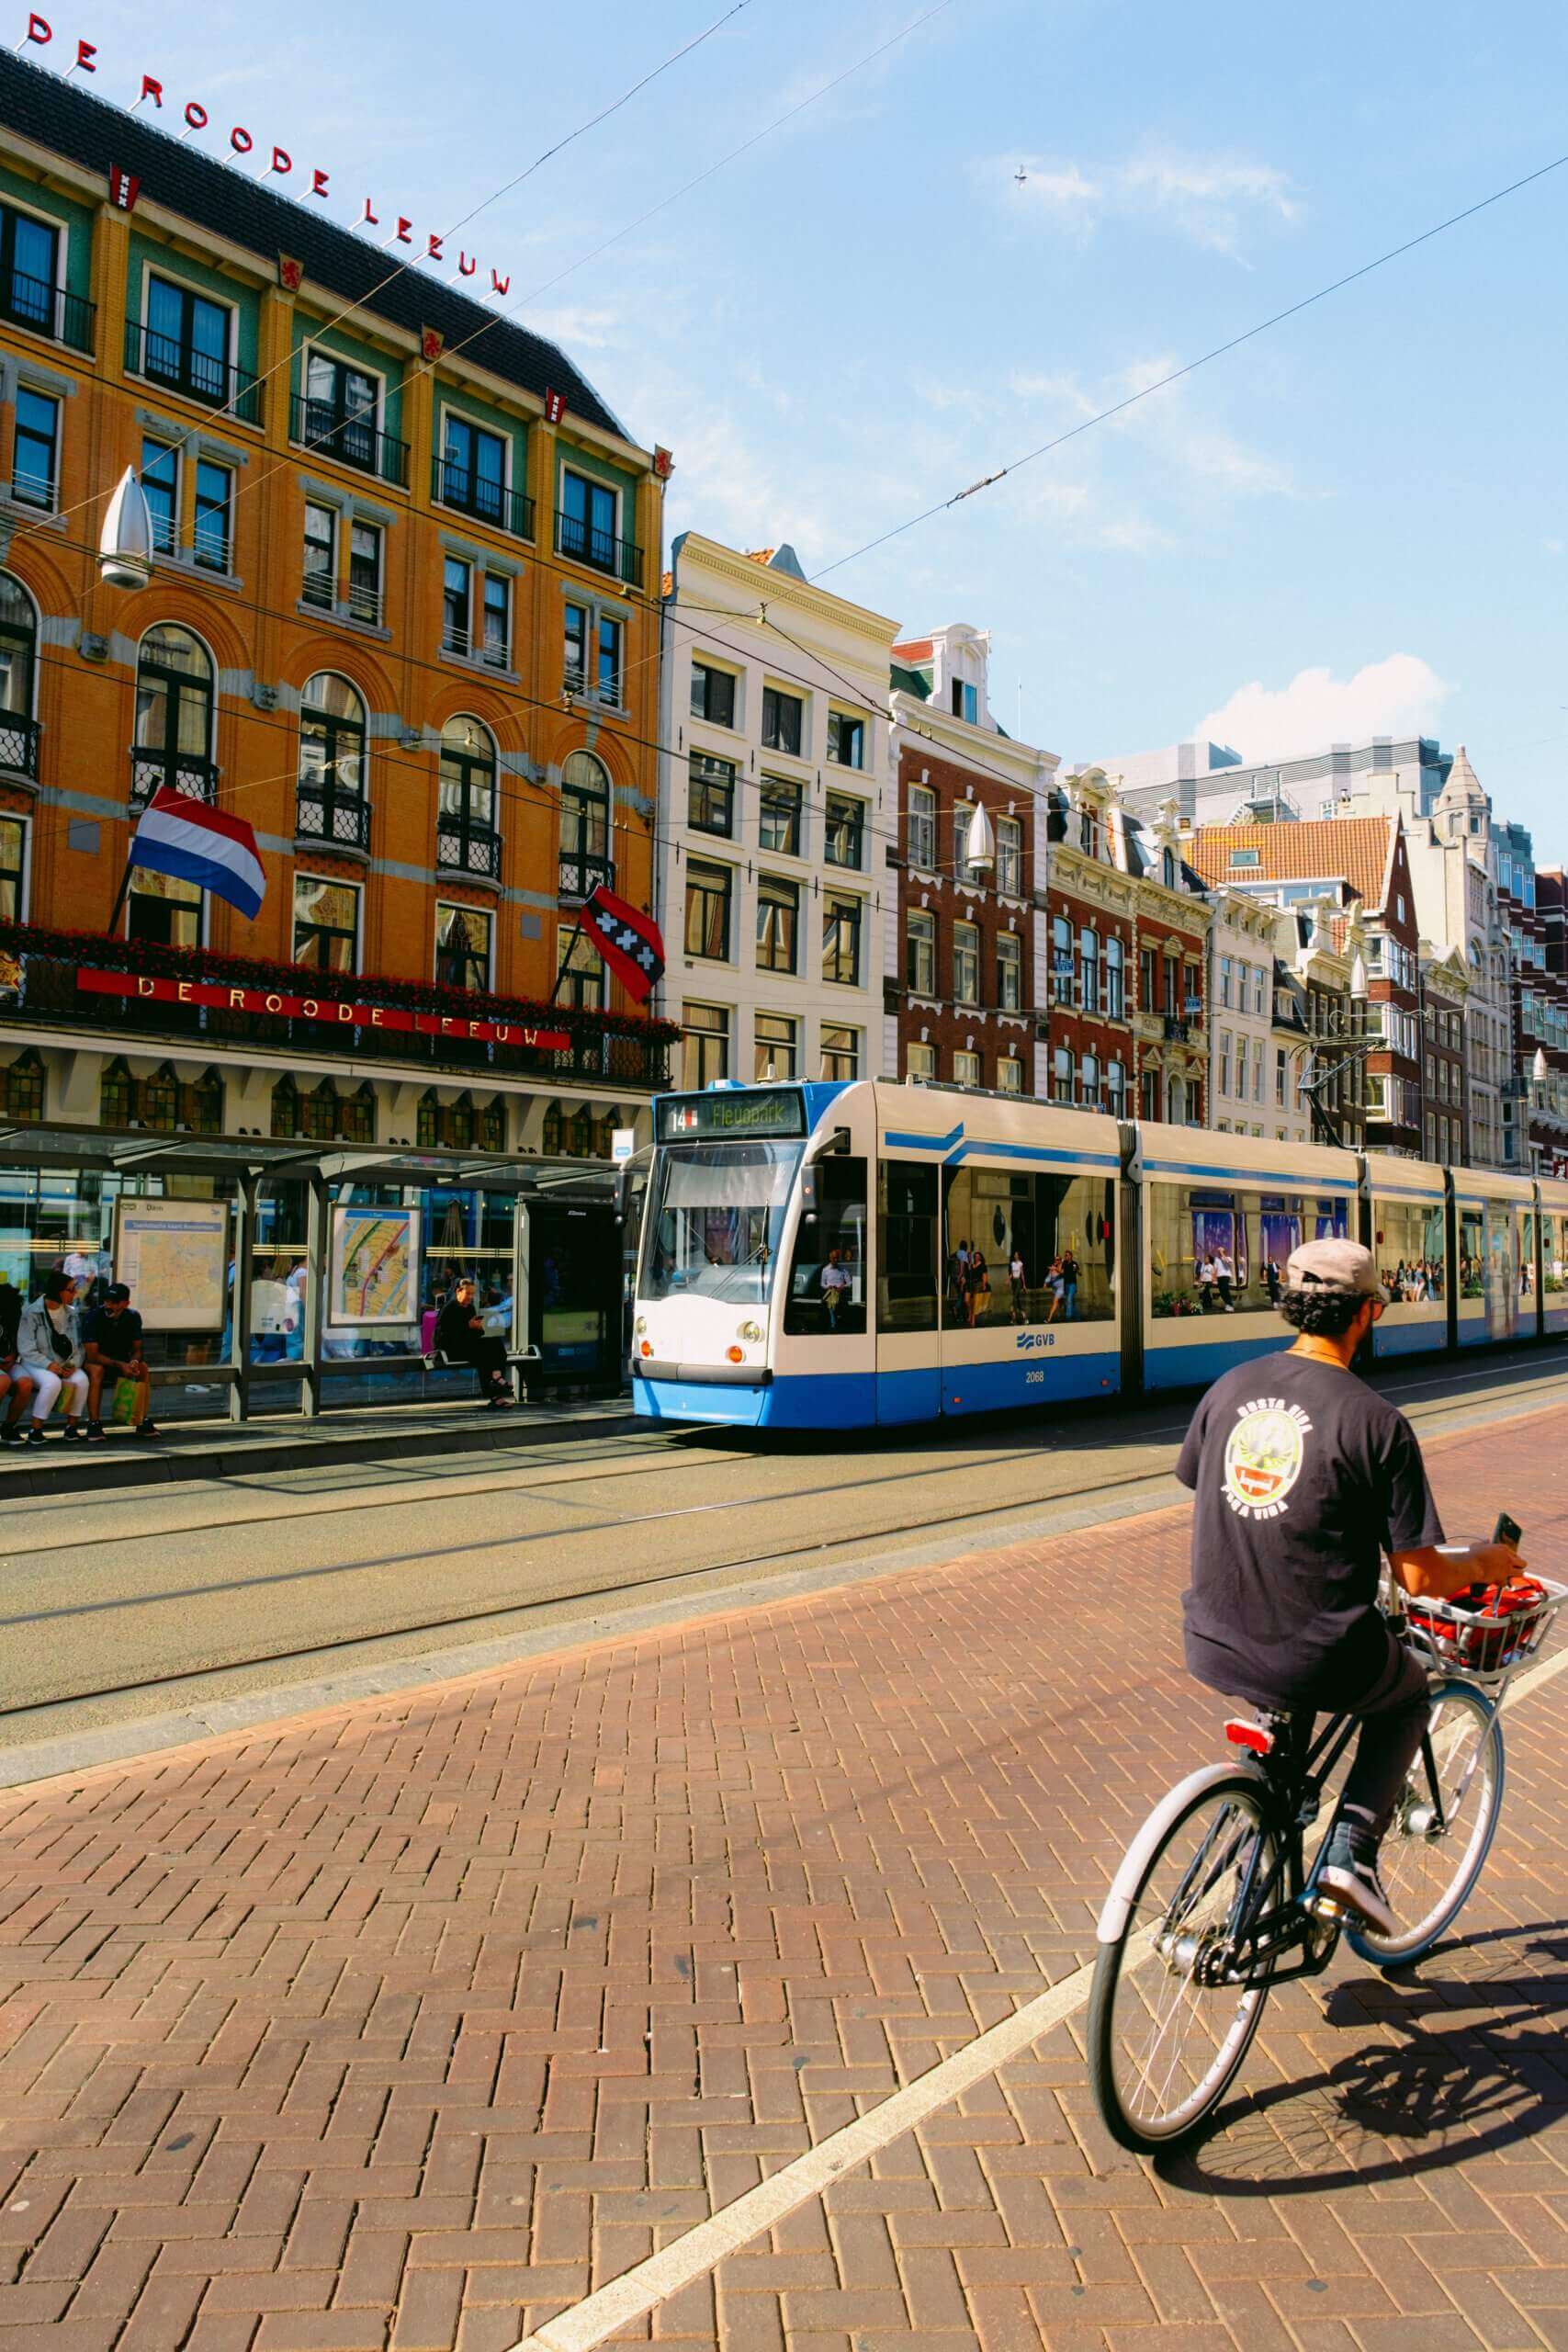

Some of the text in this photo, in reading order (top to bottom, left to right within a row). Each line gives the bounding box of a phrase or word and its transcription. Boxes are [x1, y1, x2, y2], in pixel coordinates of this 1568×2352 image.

[28, 13, 510, 295] DE ROODE LEEUW
[139, 977, 537, 1045] DE ROODE LEEUW
[671, 1106, 685, 1132] 14
[1035, 1333, 1055, 1346] GVB
[1026, 1371, 1043, 1383] 2068
[1236, 1397, 1286, 1418] COSTA
